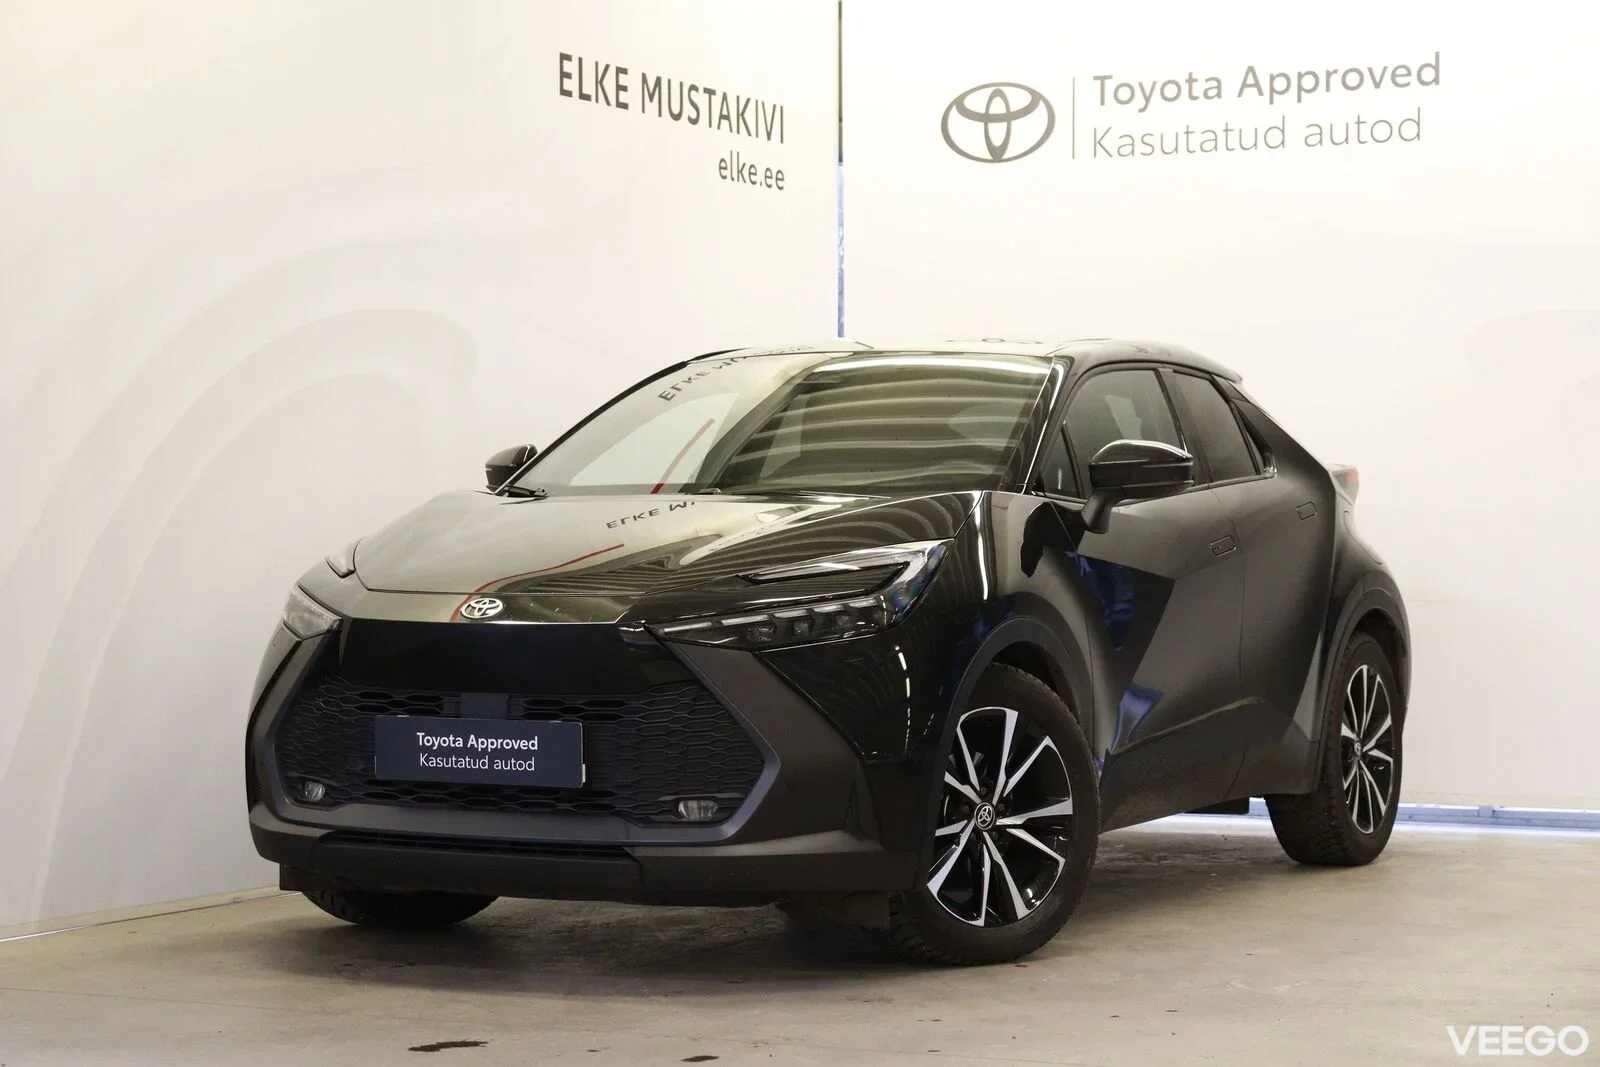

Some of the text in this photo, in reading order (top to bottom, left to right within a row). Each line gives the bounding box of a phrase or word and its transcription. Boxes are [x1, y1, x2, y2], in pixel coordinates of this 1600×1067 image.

[559, 52, 784, 144] ELKE MUSTAKIVI
[1093, 51, 1440, 113] Toyota Approved
[1093, 107, 1421, 159] Kasutatud autod
[718, 150, 785, 191] elke.ee
[416, 732, 538, 752] Toyota Approved
[419, 753, 535, 771] Kasutatud autod
